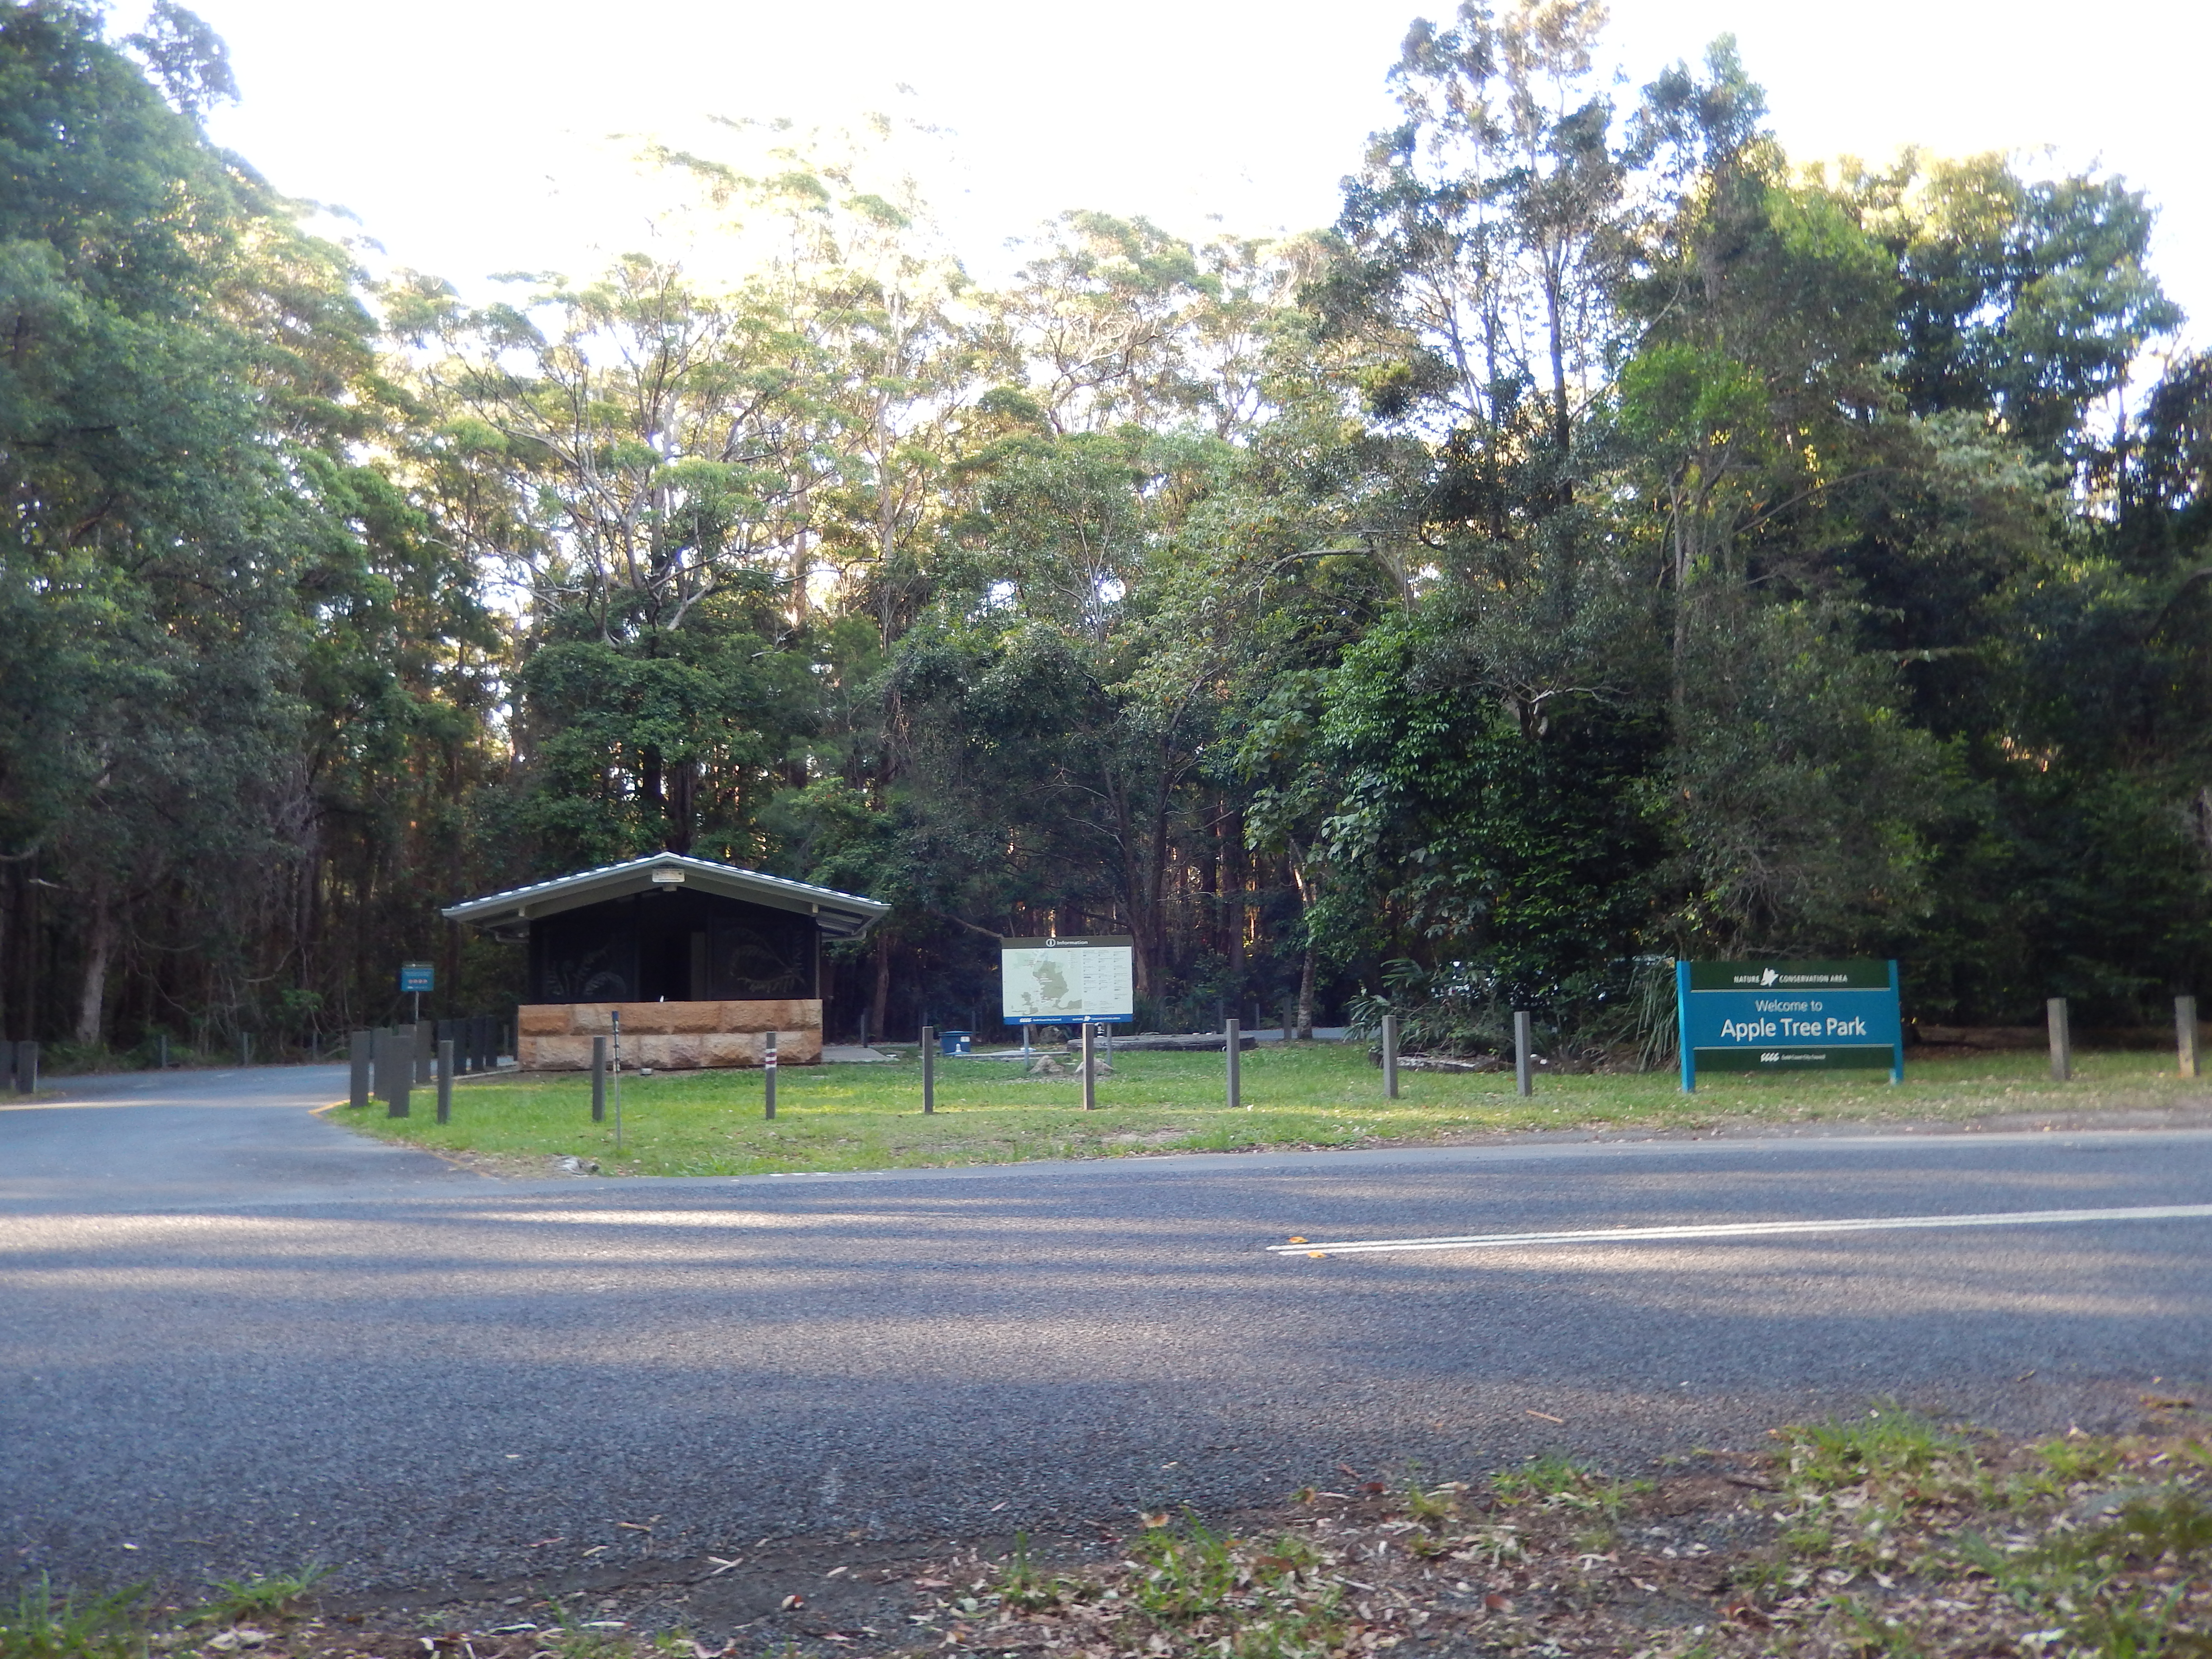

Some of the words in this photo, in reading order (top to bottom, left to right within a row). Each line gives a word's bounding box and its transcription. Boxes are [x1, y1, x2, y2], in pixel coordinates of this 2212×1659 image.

[1779, 975, 1828, 983] CONSERVATION
[1755, 999, 1807, 1012] Welcome
[1811, 1000, 1822, 1011] to
[1720, 1017, 1776, 1041] Apple
[1780, 1017, 1822, 1036] Tree
[1826, 1016, 1866, 1036] Park
